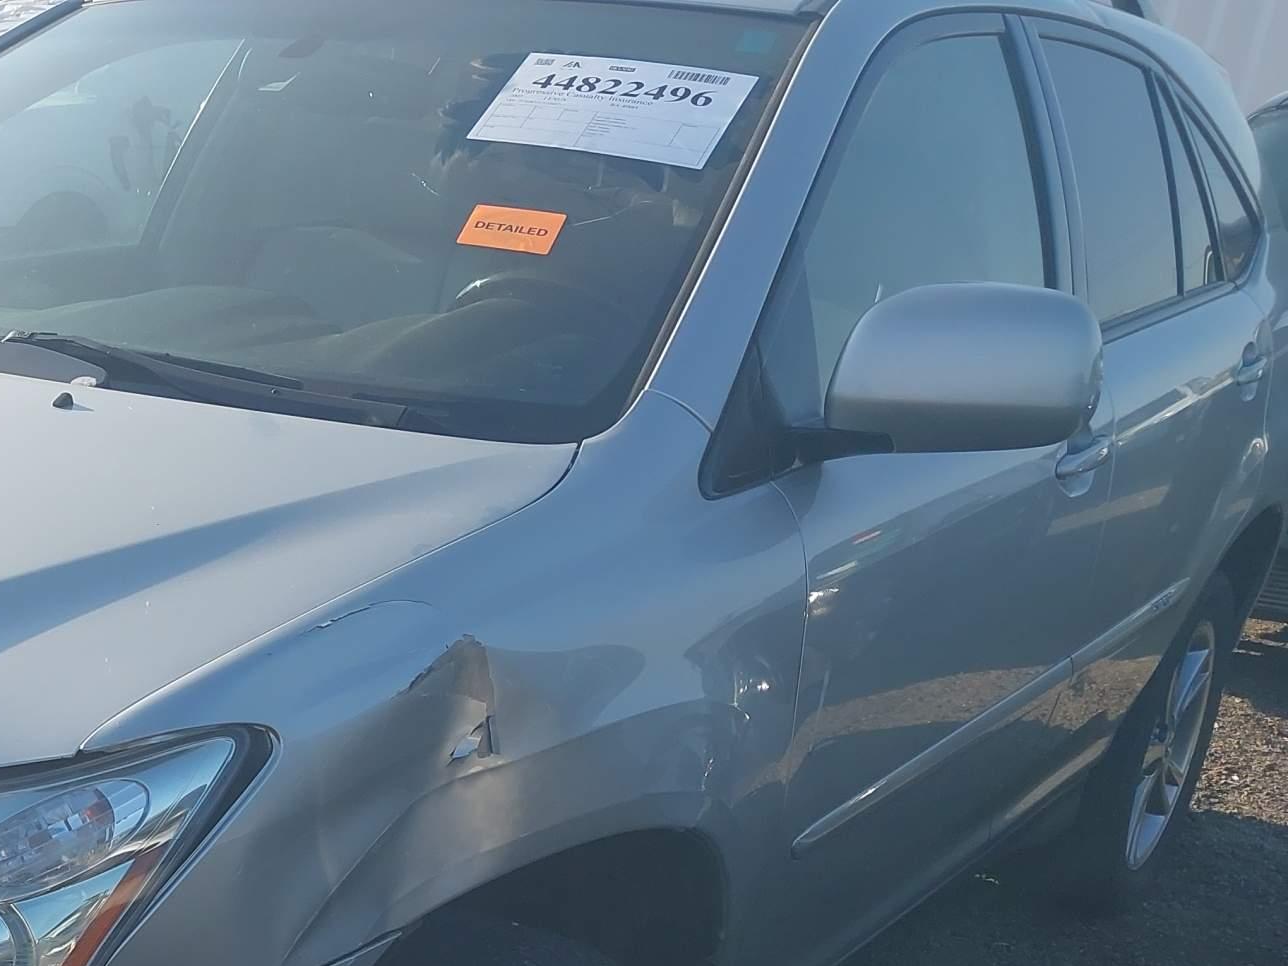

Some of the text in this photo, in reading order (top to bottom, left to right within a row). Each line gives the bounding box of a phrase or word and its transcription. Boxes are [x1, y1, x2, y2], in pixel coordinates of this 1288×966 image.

[532, 72, 719, 108] 44822496
[608, 95, 654, 106] Insurance
[474, 220, 549, 237] DETAILED
